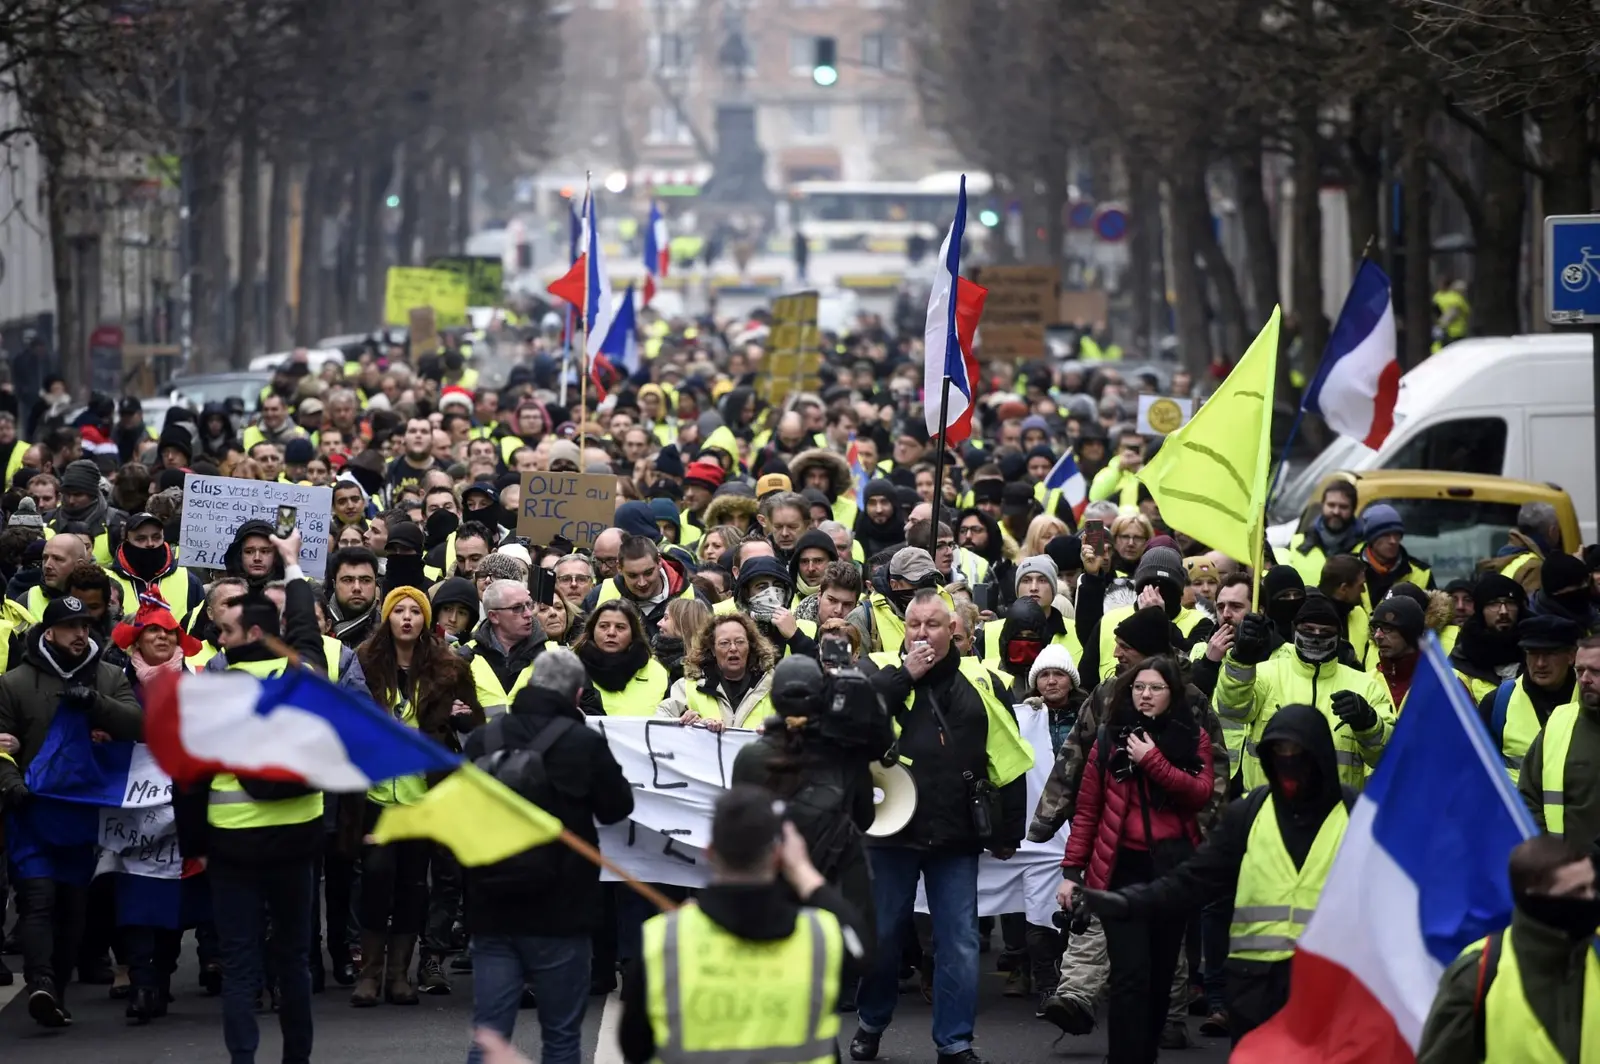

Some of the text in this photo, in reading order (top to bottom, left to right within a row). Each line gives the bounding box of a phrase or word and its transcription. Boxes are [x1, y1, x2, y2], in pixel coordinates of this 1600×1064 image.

[190, 480, 222, 496] Elus
[228, 485, 258, 497] vous
[528, 476, 609, 500] OUI au
[189, 499, 229, 510] service
[232, 501, 247, 512] du
[304, 511, 328, 521] pour
[524, 498, 568, 519] RIC
[185, 524, 208, 538] pour
[187, 511, 203, 520] son
[207, 510, 228, 522] bien
[308, 519, 323, 533] 68
[560, 521, 608, 544] CAR
[185, 537, 211, 549] nous
[298, 547, 319, 559] EN
